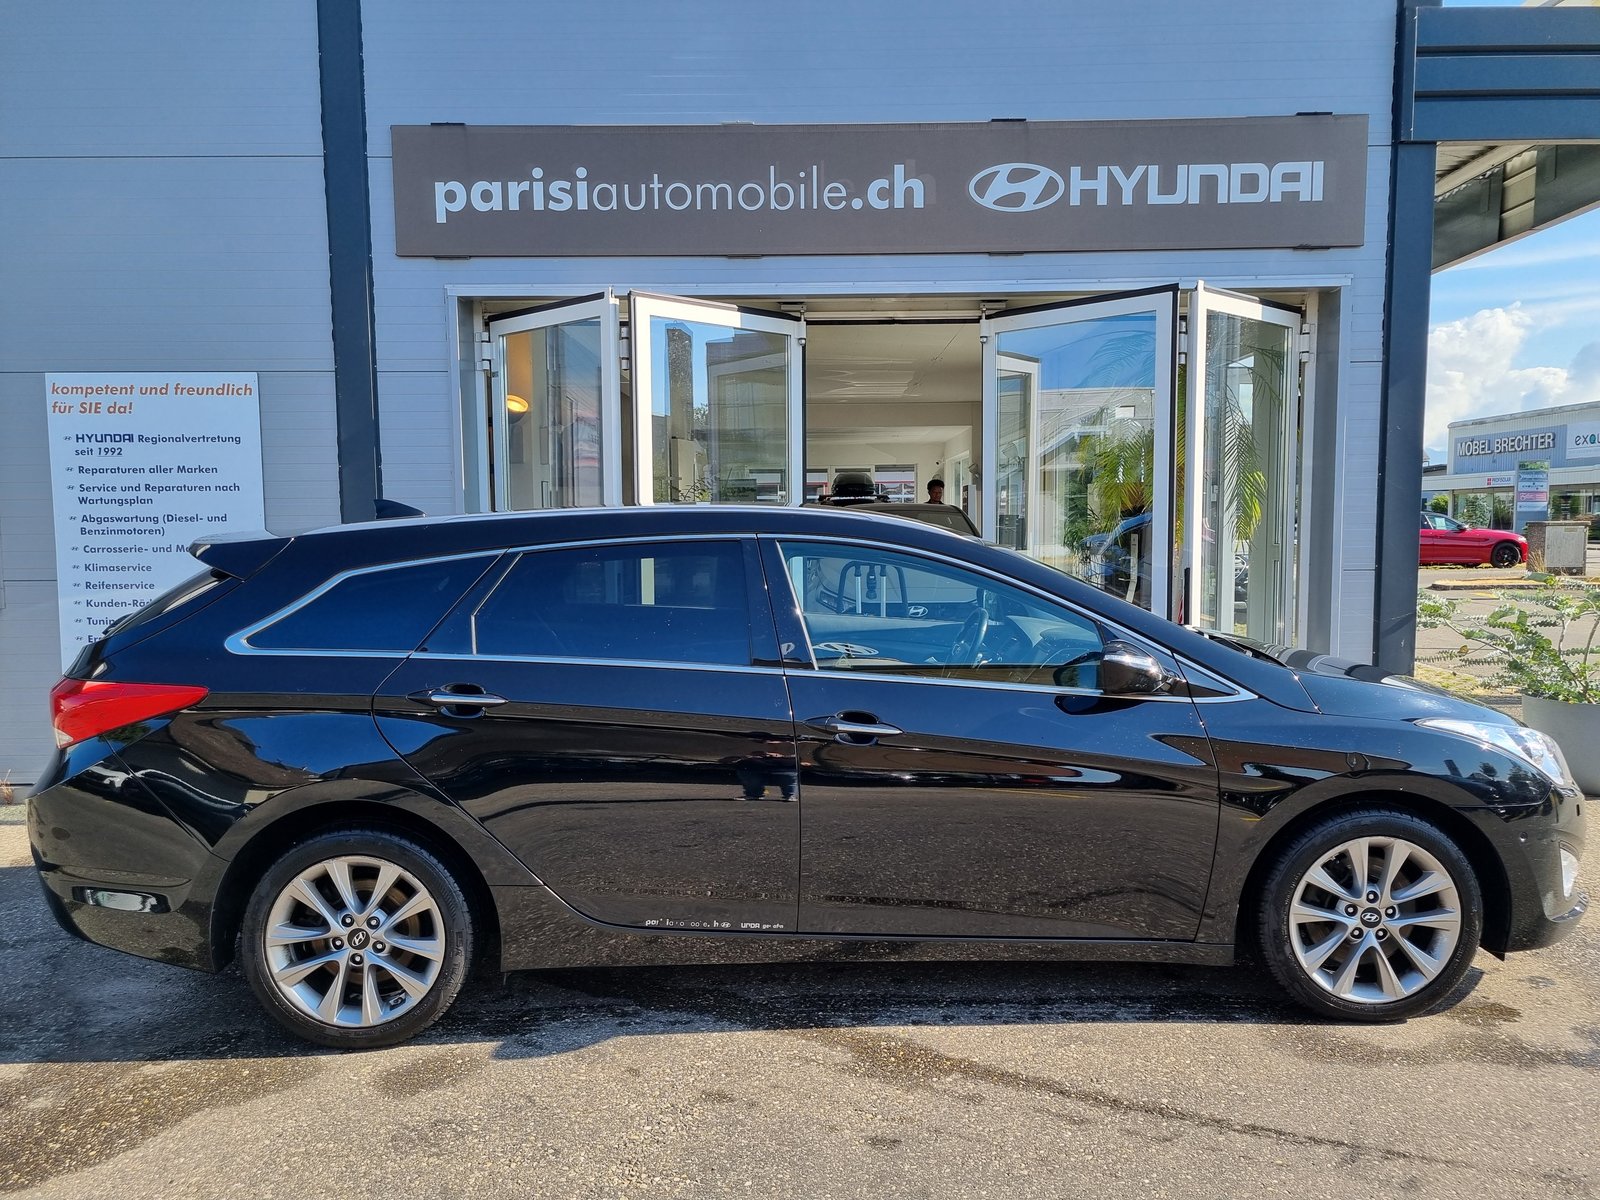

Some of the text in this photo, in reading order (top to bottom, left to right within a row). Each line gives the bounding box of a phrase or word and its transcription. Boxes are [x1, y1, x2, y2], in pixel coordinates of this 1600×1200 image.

[1070, 161, 1324, 206] HYUNDAI
[435, 164, 924, 223] parisiautomobile.ch
[52, 383, 252, 398] kompetent und freundlich
[52, 402, 132, 414] für SIE da!
[76, 434, 240, 445] HYUNDAI Regionalvertretung
[1494, 432, 1555, 453] BRECHTER
[75, 447, 122, 455] seit 1992
[78, 465, 217, 476] Reparaturen aller Marken
[80, 483, 240, 494] Service und Reparaturen nach
[78, 496, 153, 506] Wartungsplan
[81, 514, 227, 525] Abgaswartung (Diesel- und
[81, 527, 164, 536] Benzinmotoren)
[84, 545, 148, 553] Carrosserie-
[152, 544, 172, 552] und
[85, 563, 151, 571] Klimaservice
[86, 581, 154, 589] Reifenservice
